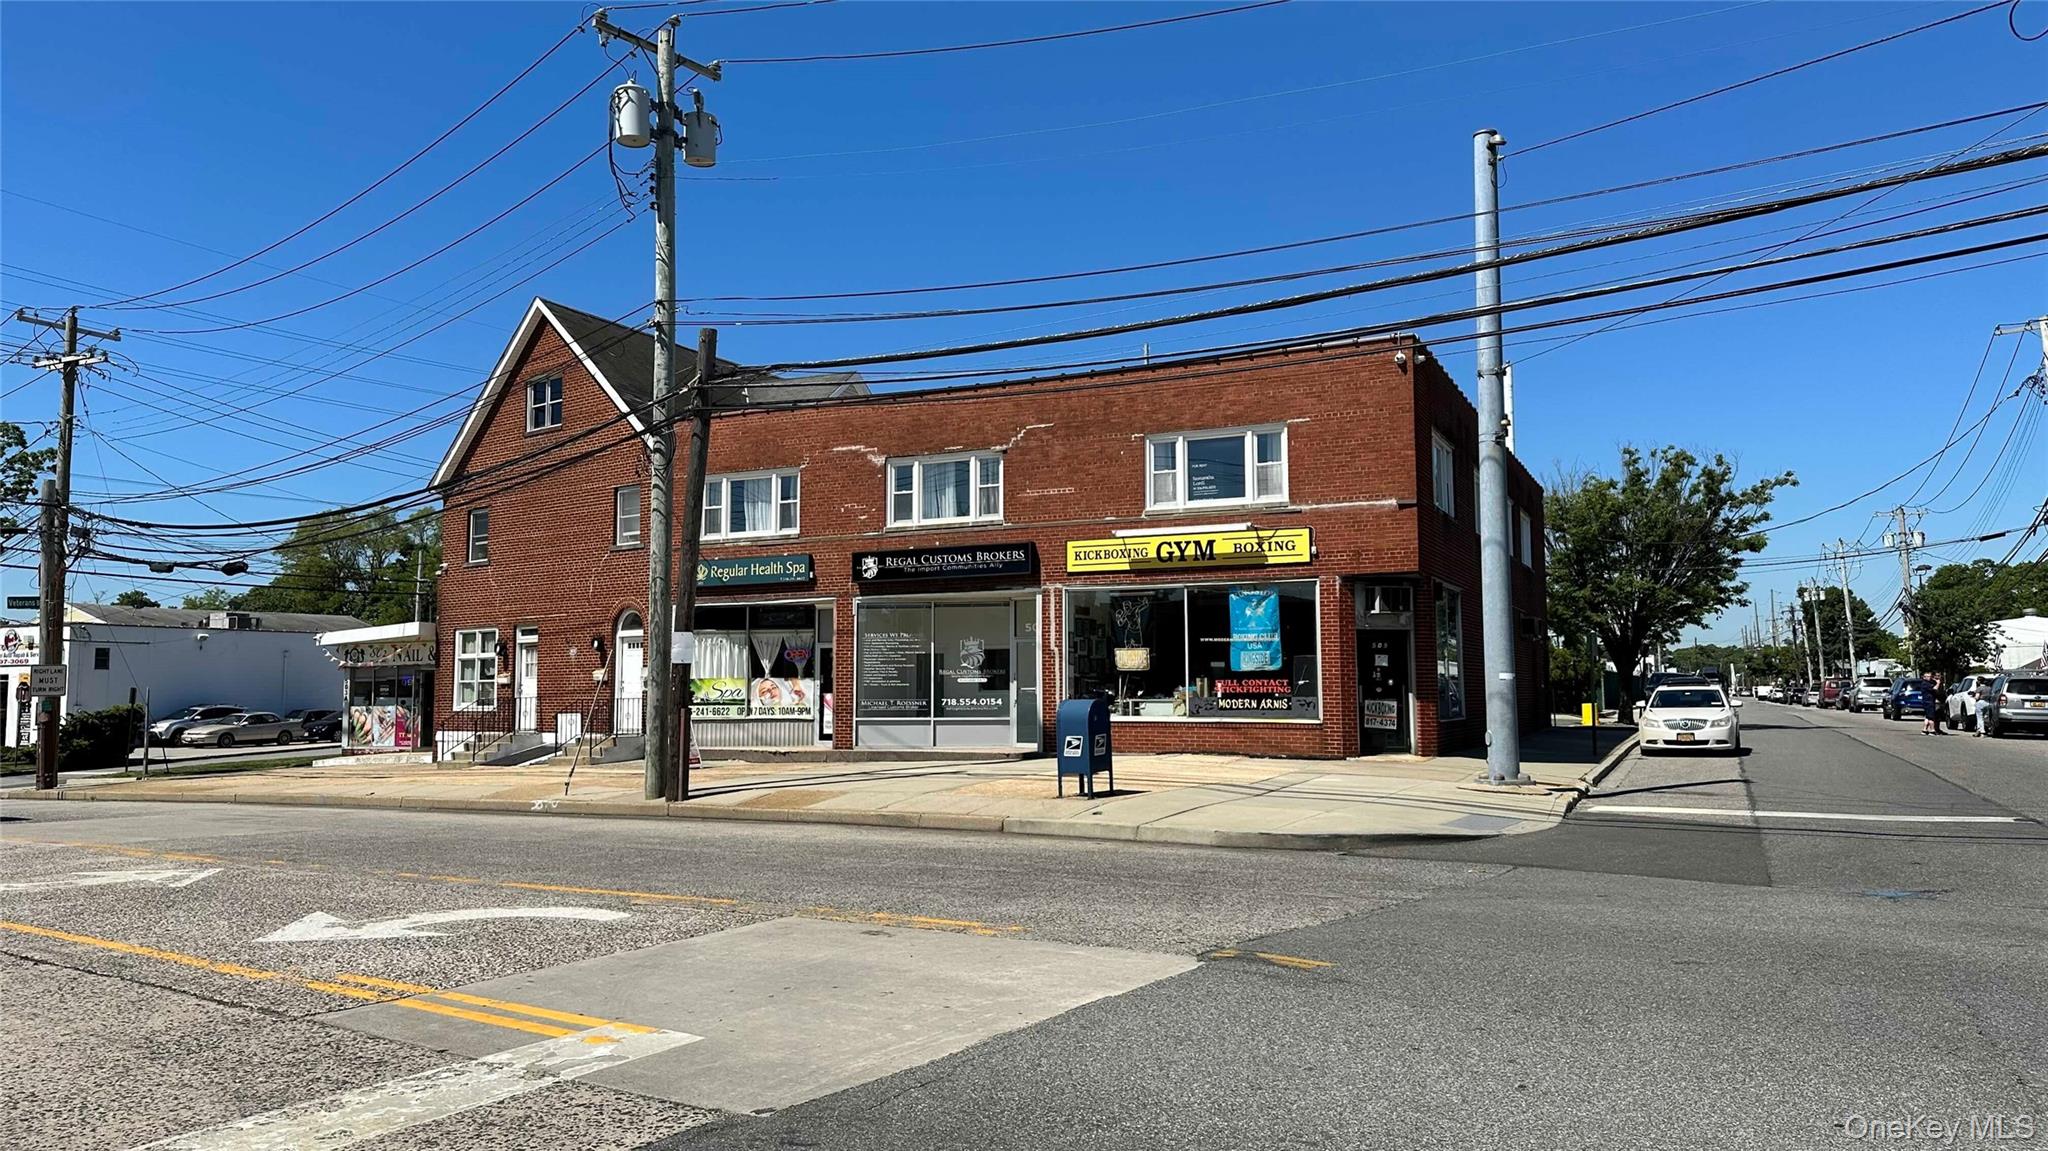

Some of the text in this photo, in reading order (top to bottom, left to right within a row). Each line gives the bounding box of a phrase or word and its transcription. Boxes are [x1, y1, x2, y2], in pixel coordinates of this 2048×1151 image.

[1074, 539, 1296, 563] KICKBOXING GYM BOXING
[885, 550, 1025, 567] REGAL CUSTOMS BROKERS
[710, 561, 806, 581] Regular Health Spa
[942, 563, 987, 571] Communities
[989, 562, 1003, 570] Ally
[1025, 623, 1037, 632] 50
[392, 646, 423, 662] NAIL
[427, 645, 436, 661] &
[711, 681, 744, 703] Spa
[941, 698, 1003, 706] 718.554.0154
[1218, 698, 1288, 709] MODERN ARNIS
[737, 707, 753, 715] OPN
[754, 707, 759, 715] 7
[778, 707, 811, 715] 10AM-9PM
